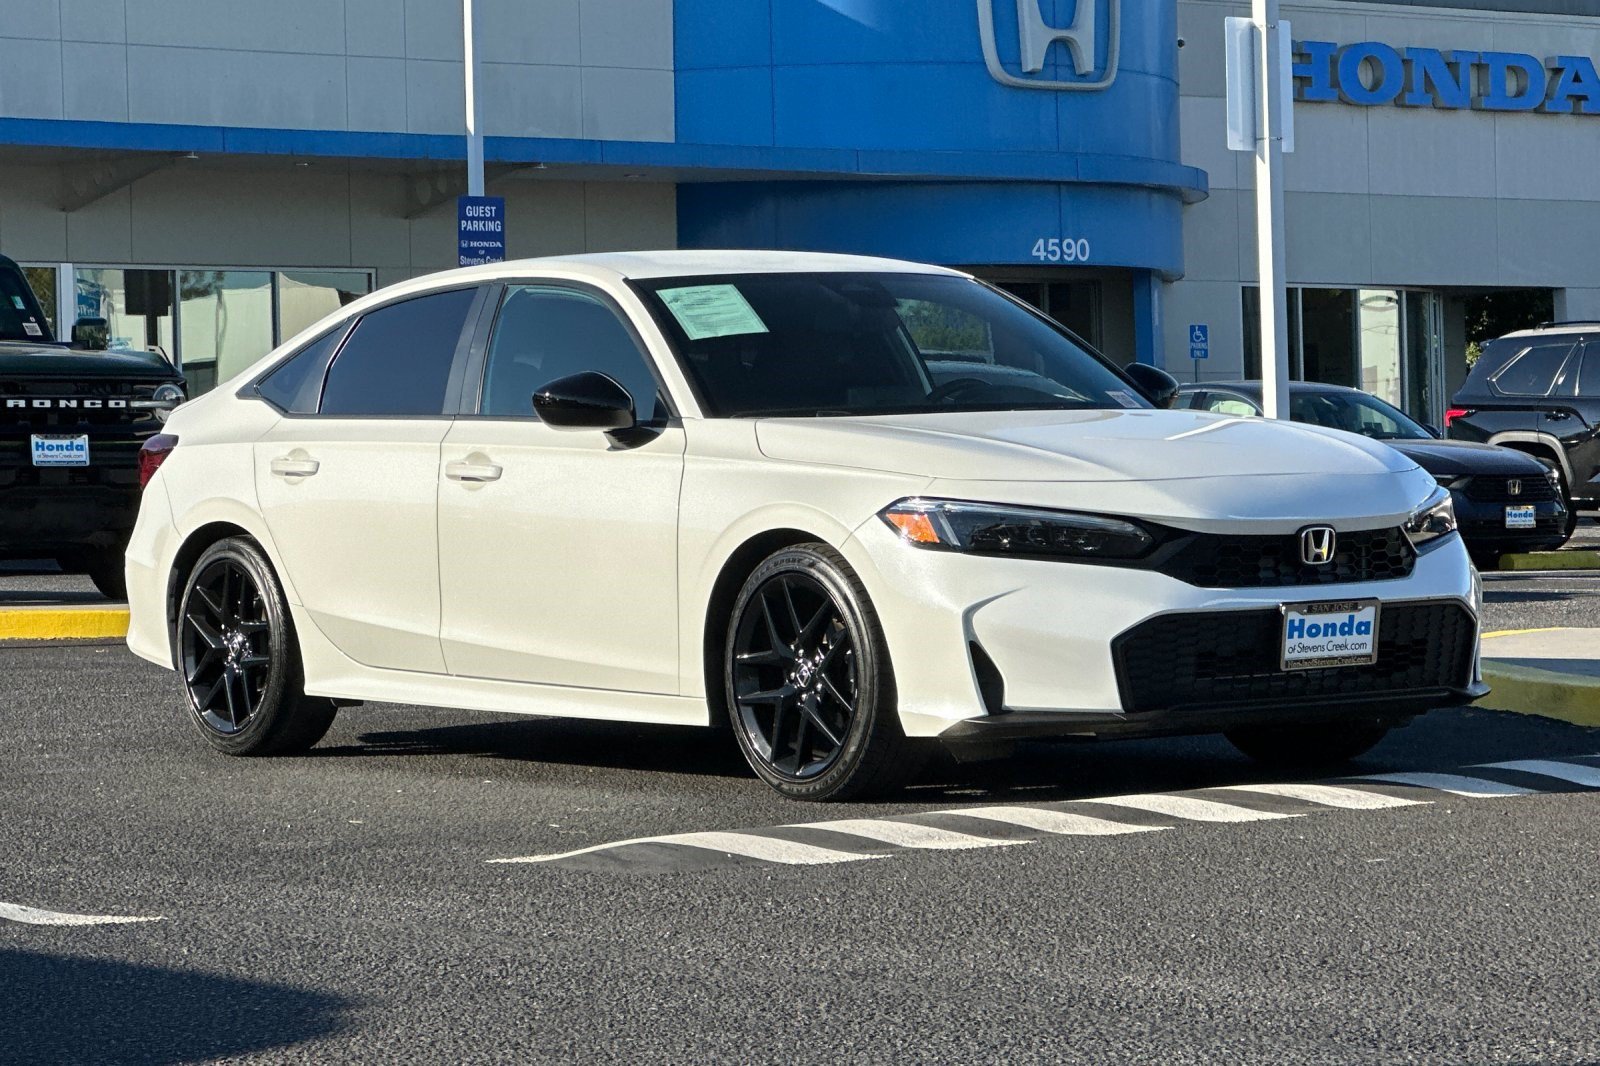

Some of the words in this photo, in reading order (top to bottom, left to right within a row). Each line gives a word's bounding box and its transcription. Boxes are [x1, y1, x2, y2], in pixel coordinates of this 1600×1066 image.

[1292, 40, 1600, 114] HONDA
[466, 205, 497, 217] GUEST
[461, 220, 502, 232] PARKING
[1031, 238, 1090, 262] 4590
[460, 255, 485, 265] Stevens
[35, 440, 85, 452] Honda
[1507, 510, 1534, 519] Honda
[1311, 604, 1330, 613] SAN
[1331, 603, 1354, 612] JOSE
[1287, 614, 1372, 640] Honda
[1287, 644, 1297, 655] of
[1296, 642, 1326, 654] Stevens
[1326, 638, 1368, 652] Creek.com
